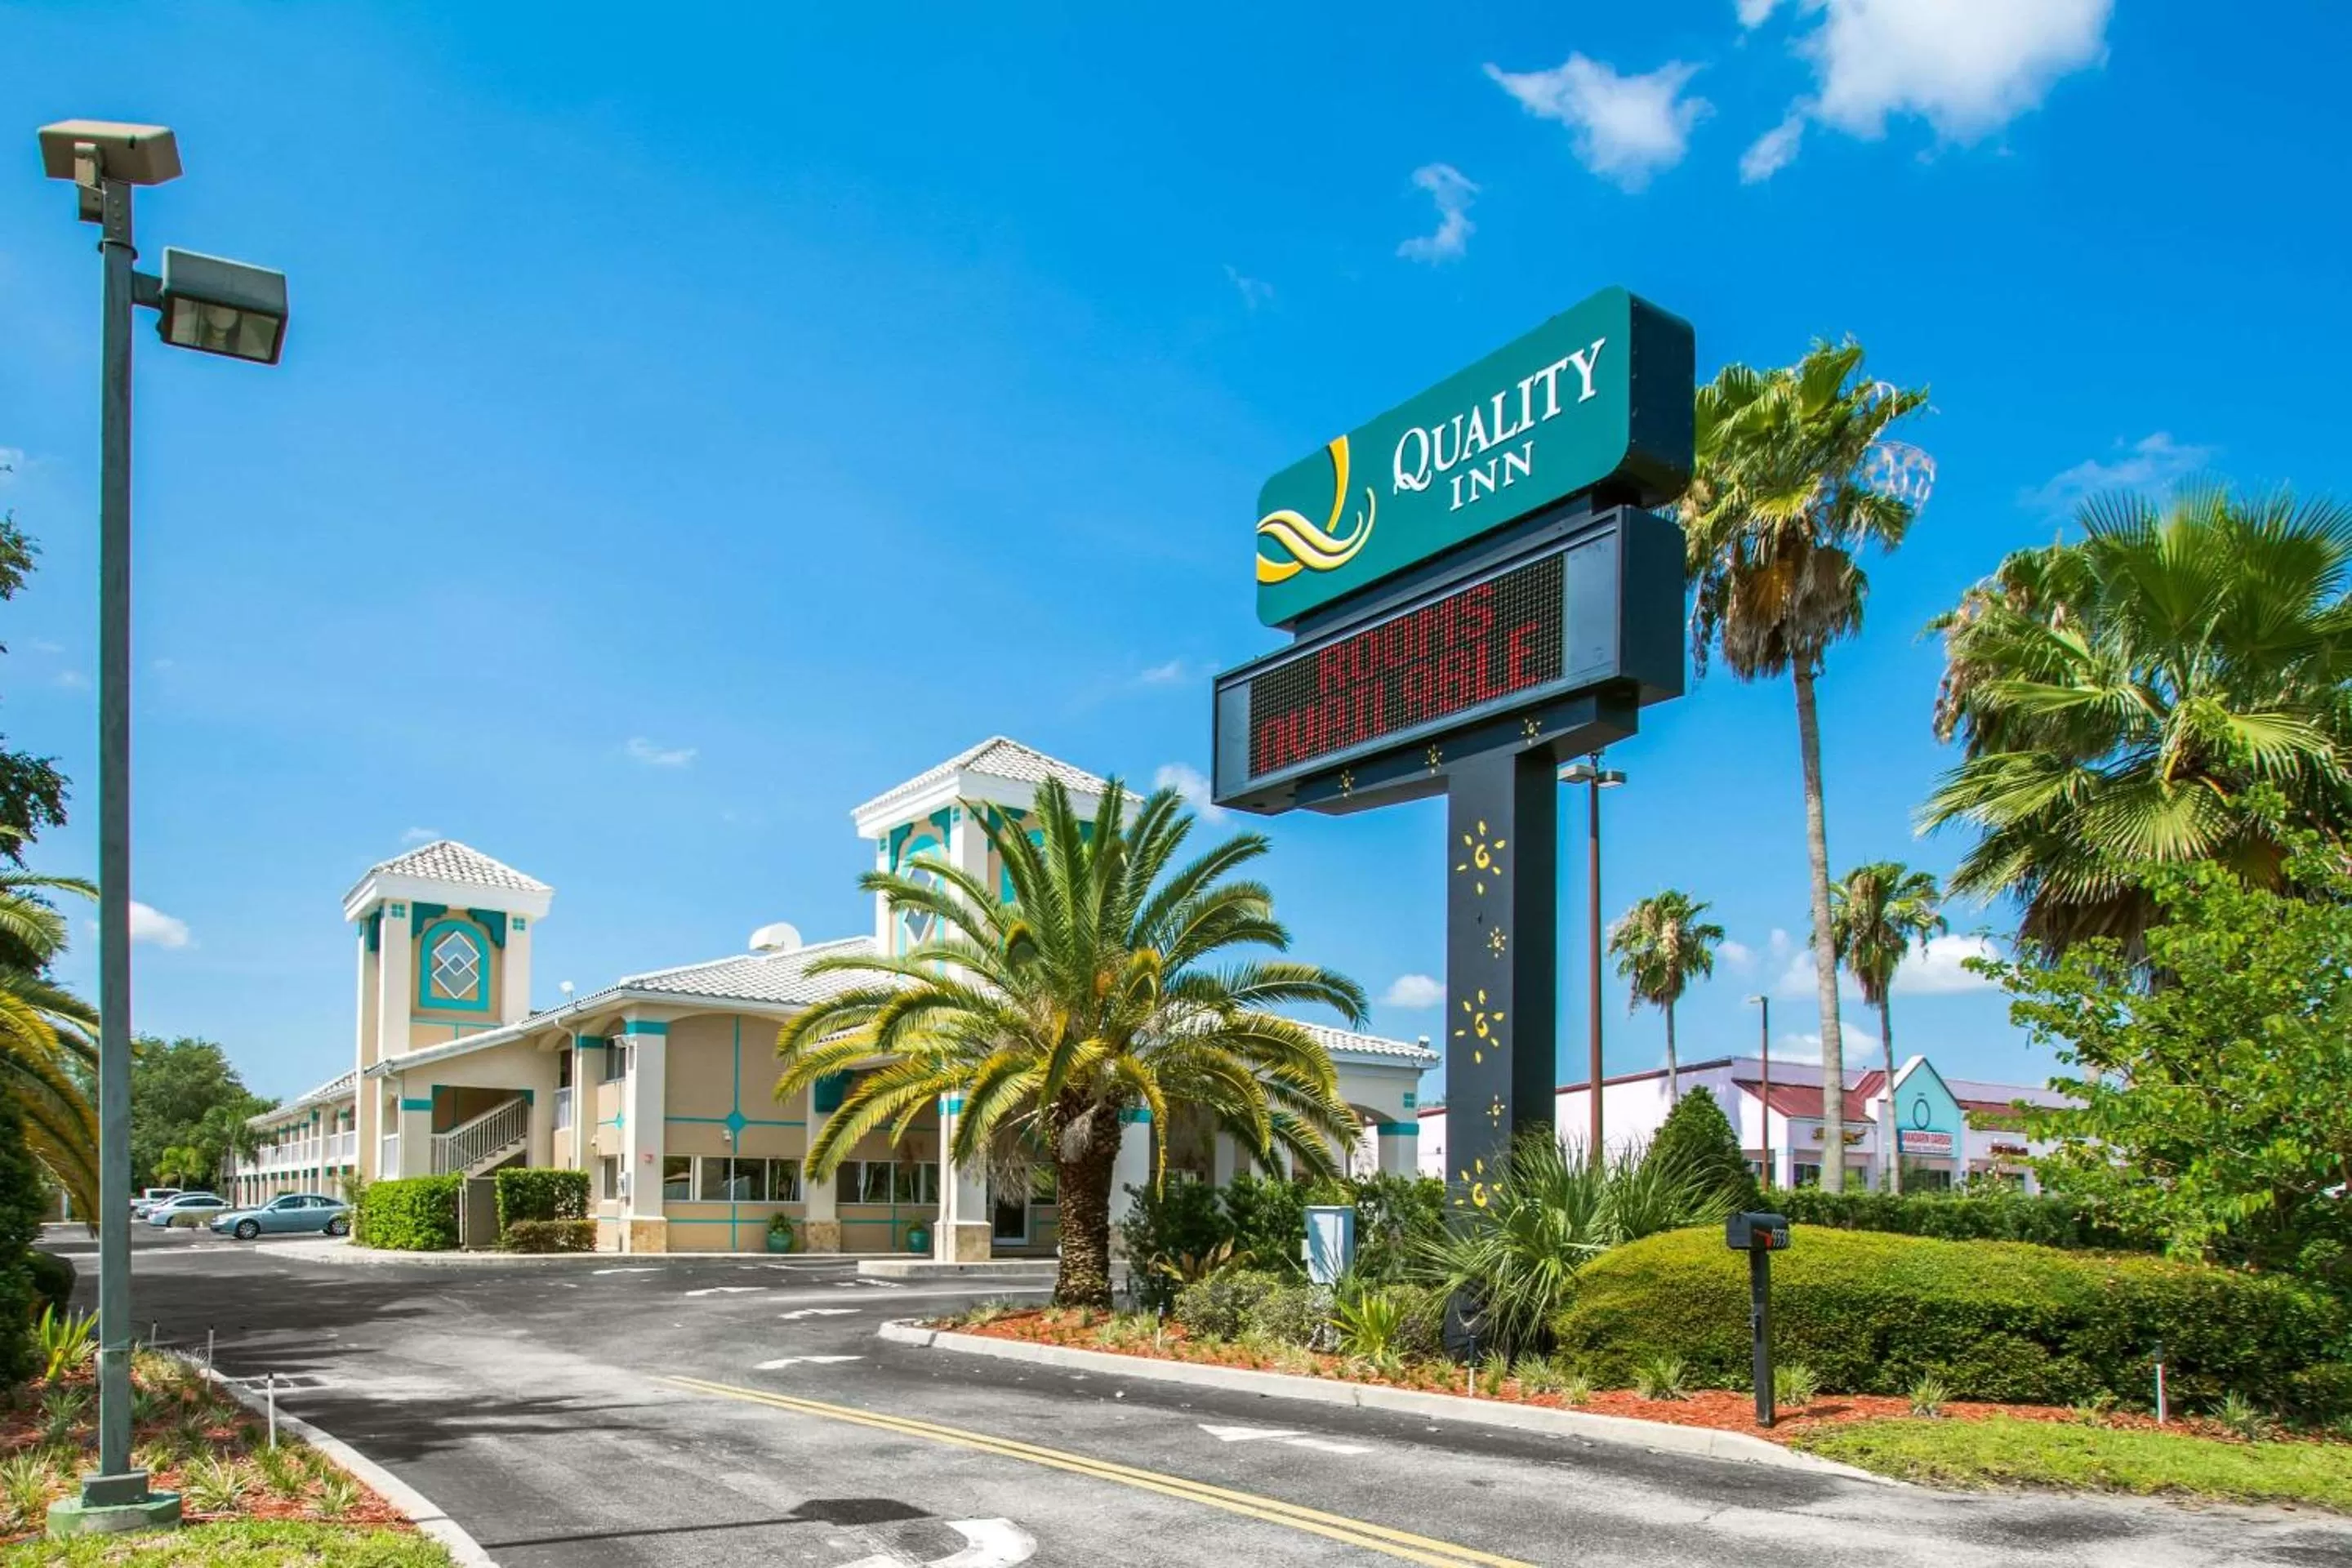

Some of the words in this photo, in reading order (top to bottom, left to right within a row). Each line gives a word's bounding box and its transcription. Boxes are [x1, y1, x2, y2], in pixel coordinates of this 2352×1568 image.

[1392, 336, 1606, 495] QUALITY
[1449, 440, 1535, 511] INN
[1257, 619, 1539, 775] AVAILABLE
[1319, 583, 1495, 695] ROOMS
